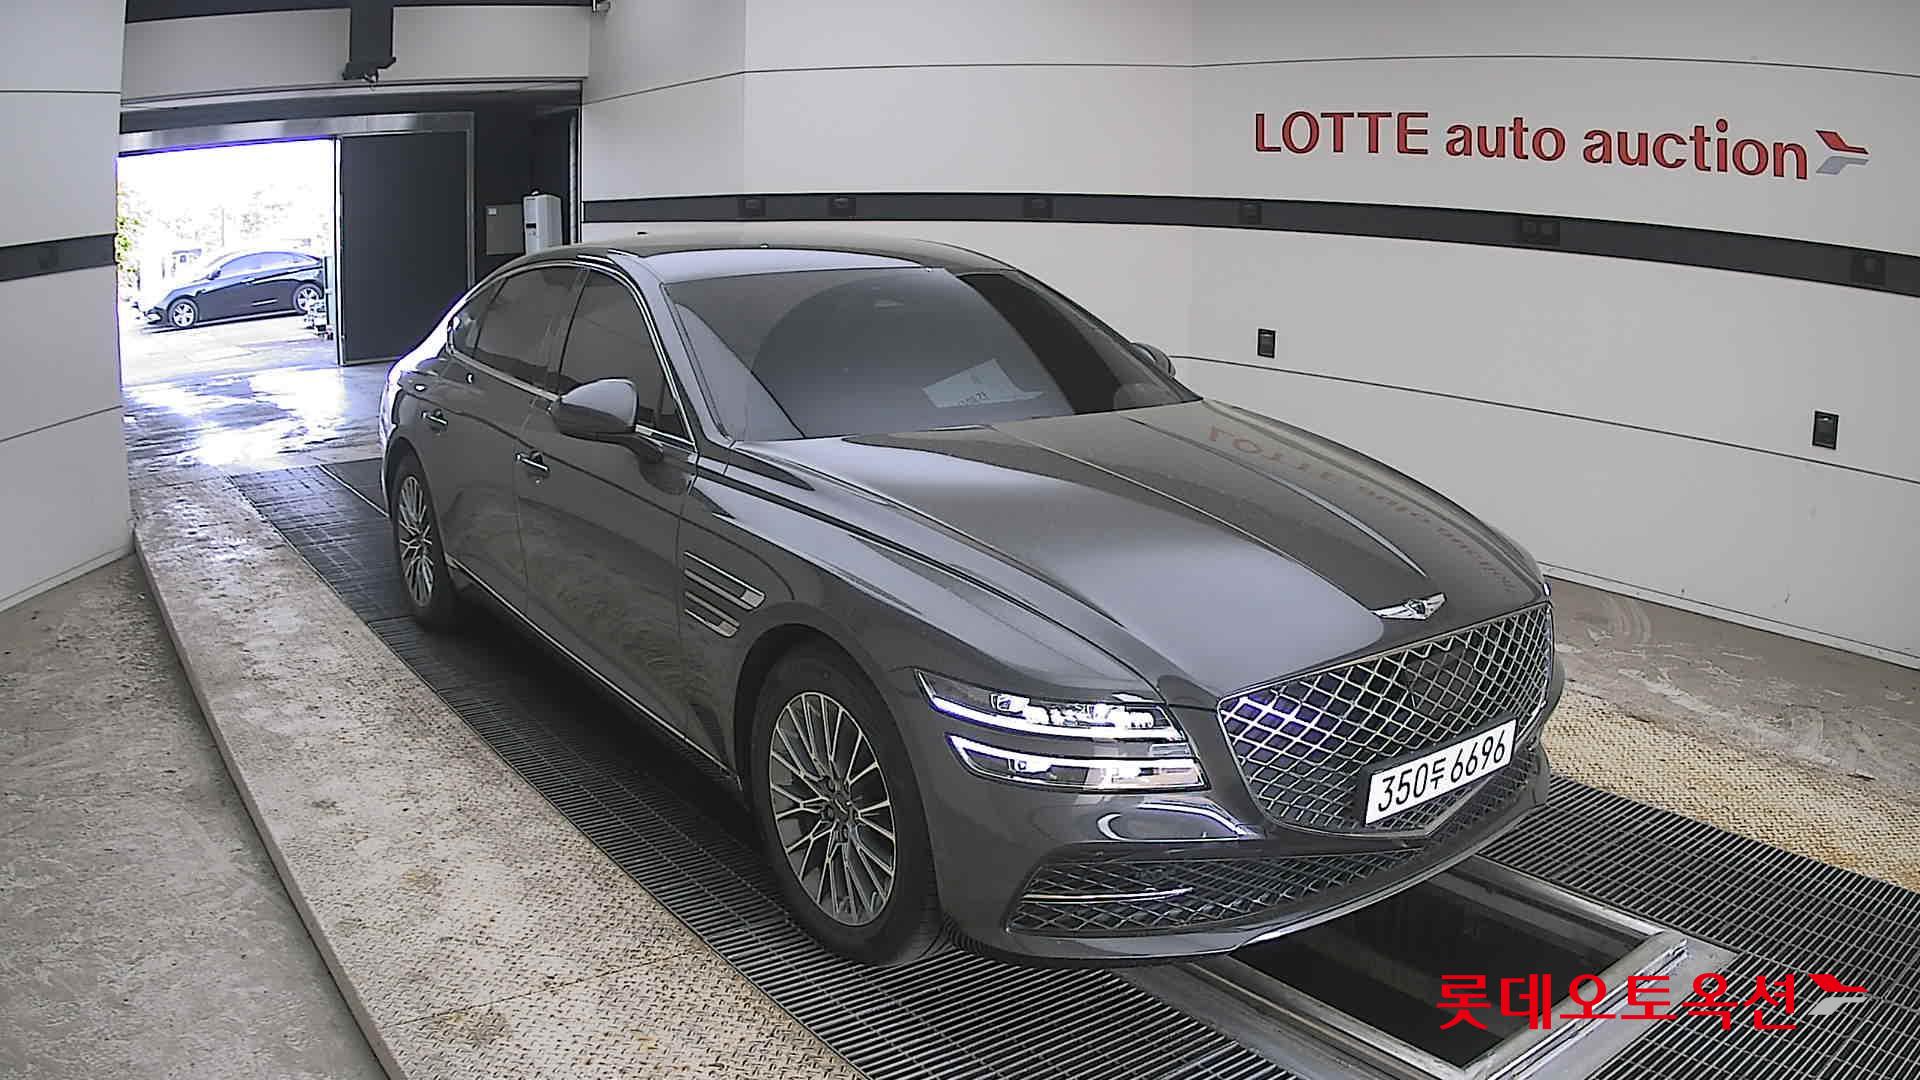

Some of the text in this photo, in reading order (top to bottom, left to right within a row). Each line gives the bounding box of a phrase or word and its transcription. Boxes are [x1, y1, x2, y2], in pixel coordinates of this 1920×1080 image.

[1255, 111, 1809, 181] LOTTE auto auction
[1450, 729, 1506, 784] 6696
